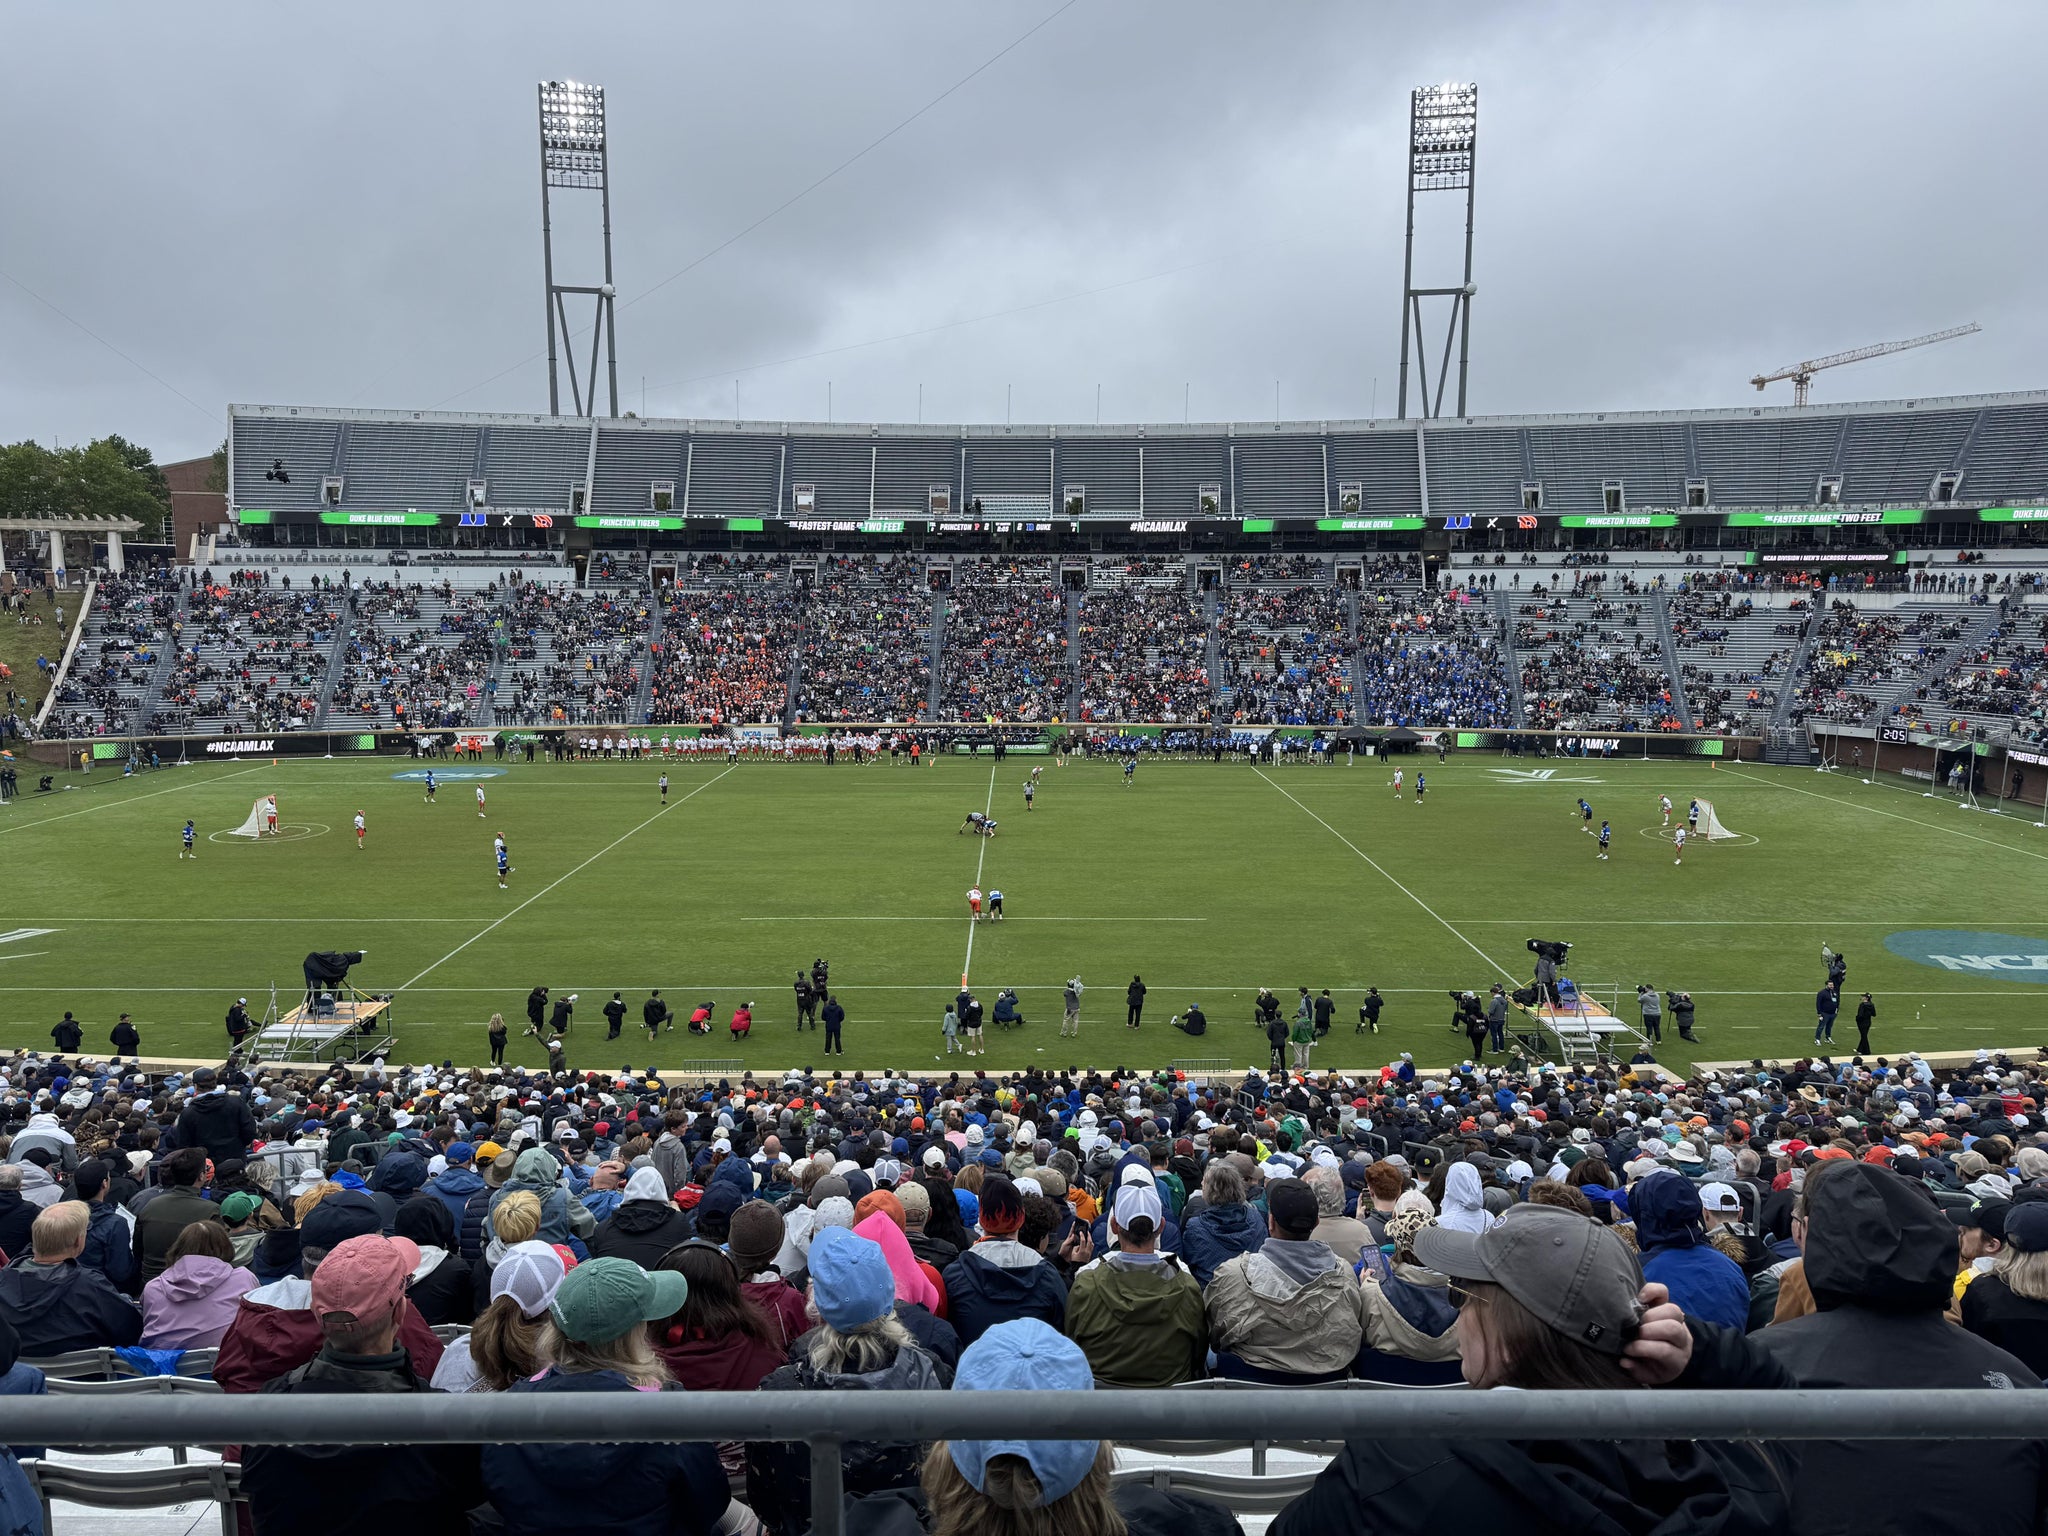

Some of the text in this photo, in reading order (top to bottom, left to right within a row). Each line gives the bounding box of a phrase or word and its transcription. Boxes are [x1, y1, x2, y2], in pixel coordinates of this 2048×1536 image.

[349, 515, 405, 523] DUKE BLUE DEVILS
[1772, 515, 1809, 524] FASTEST
[1808, 514, 1833, 523] GAME
[1840, 513, 1860, 522] TWO
[1860, 512, 1882, 522] FEET
[2012, 510, 2033, 519] DUKE
[599, 519, 660, 527] PRINCETON TIGERS
[798, 521, 832, 531] FASTEST
[832, 521, 856, 531] GAME
[864, 522, 881, 531] TWO
[883, 522, 902, 531] FEET
[1341, 520, 1393, 529] DUKE BLUE DEVILS
[1585, 517, 1651, 526] PRINCETON TIGERS
[939, 523, 973, 531] PRINCETON
[1036, 523, 1052, 531] DUKE
[1130, 521, 1188, 532] #NCAAMLAX
[1883, 729, 1906, 741] 2:05
[206, 740, 275, 753] #NCAAMLAX
[2014, 751, 2039, 764] FASTEST
